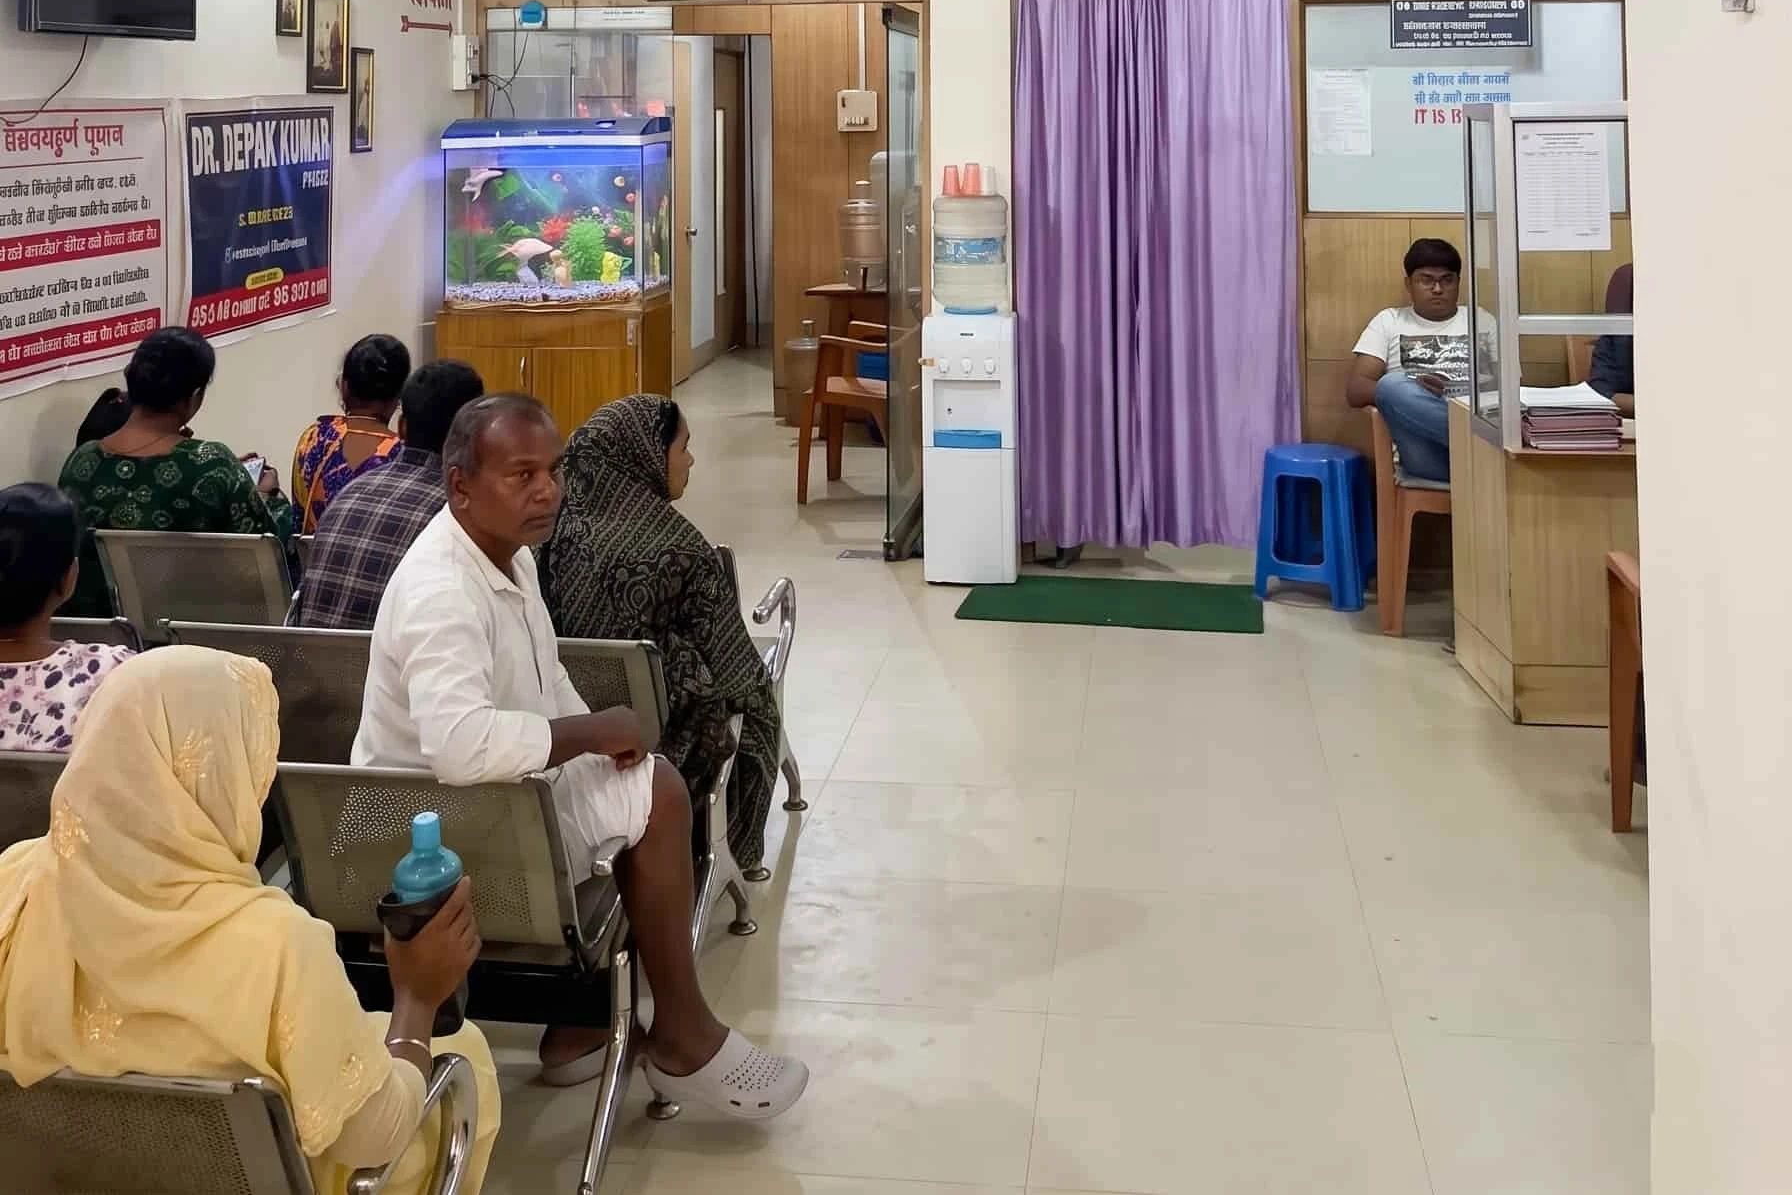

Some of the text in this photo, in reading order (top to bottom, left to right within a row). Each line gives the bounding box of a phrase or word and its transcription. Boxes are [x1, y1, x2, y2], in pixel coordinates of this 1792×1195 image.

[192, 117, 329, 176] DR. DEPAK KUMAR
